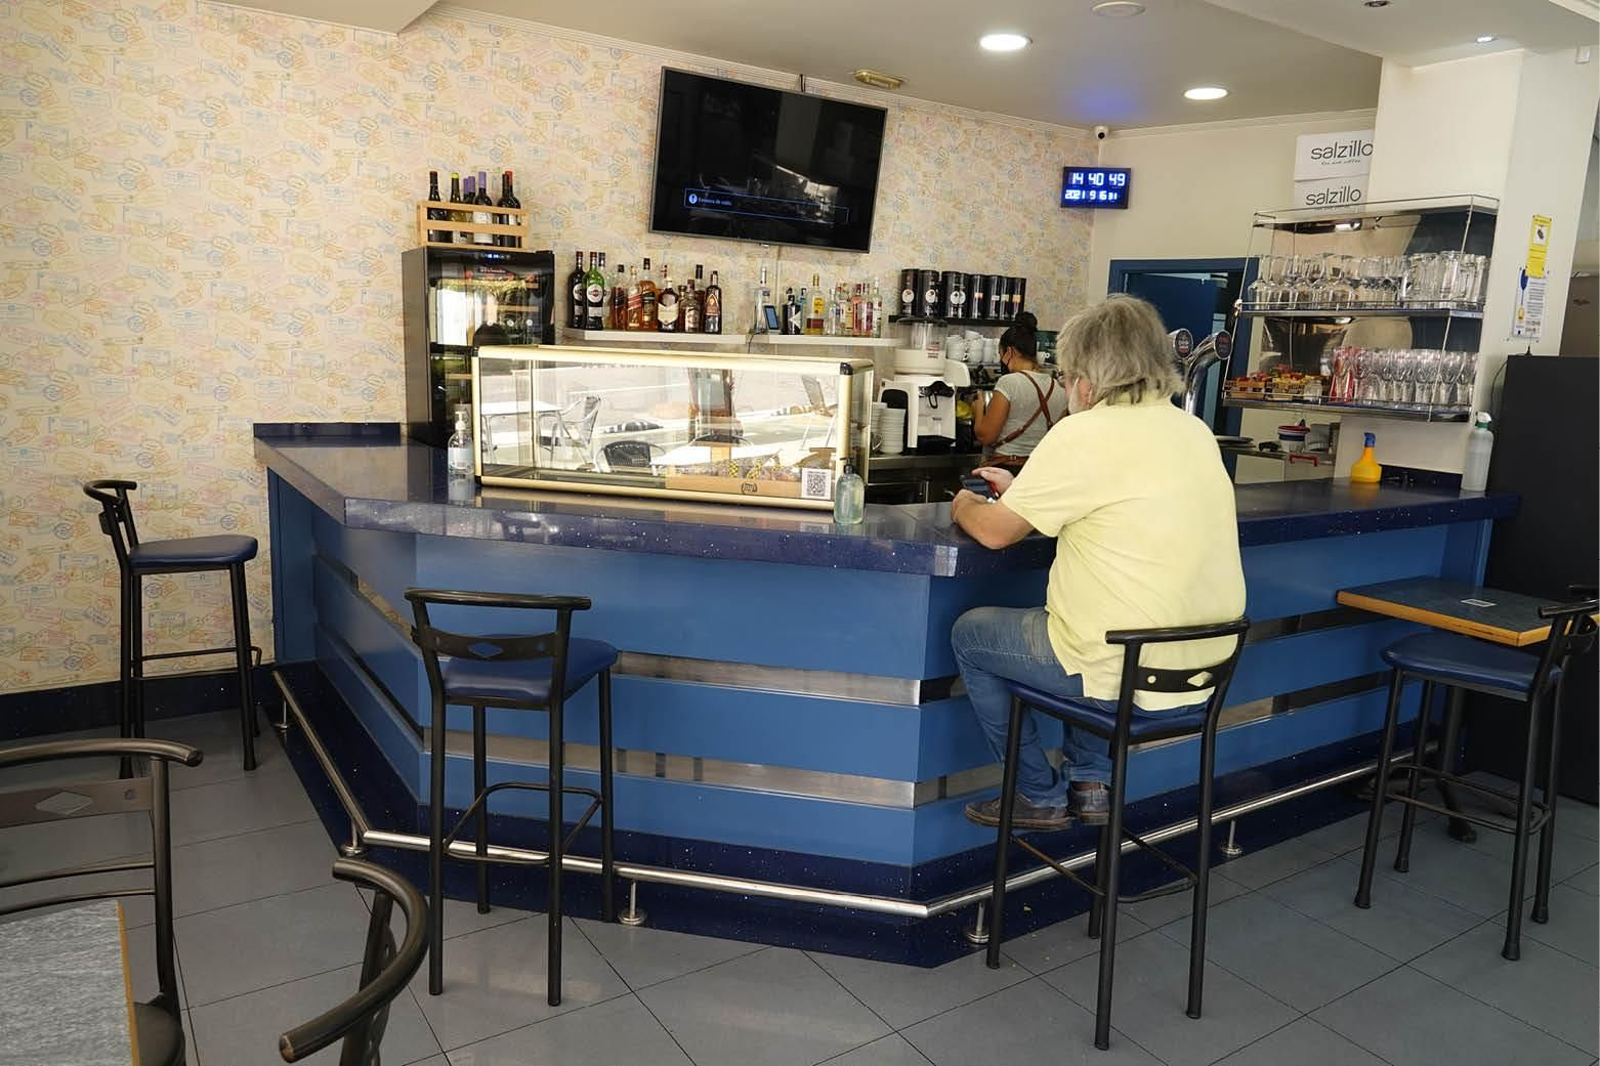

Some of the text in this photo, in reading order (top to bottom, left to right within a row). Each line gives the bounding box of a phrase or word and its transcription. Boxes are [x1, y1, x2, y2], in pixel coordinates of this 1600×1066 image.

[1310, 139, 1374, 160] salzillo
[1072, 172, 1126, 187] 14 40 49
[1065, 189, 1086, 200] 2021
[1305, 185, 1362, 206] salzillo
